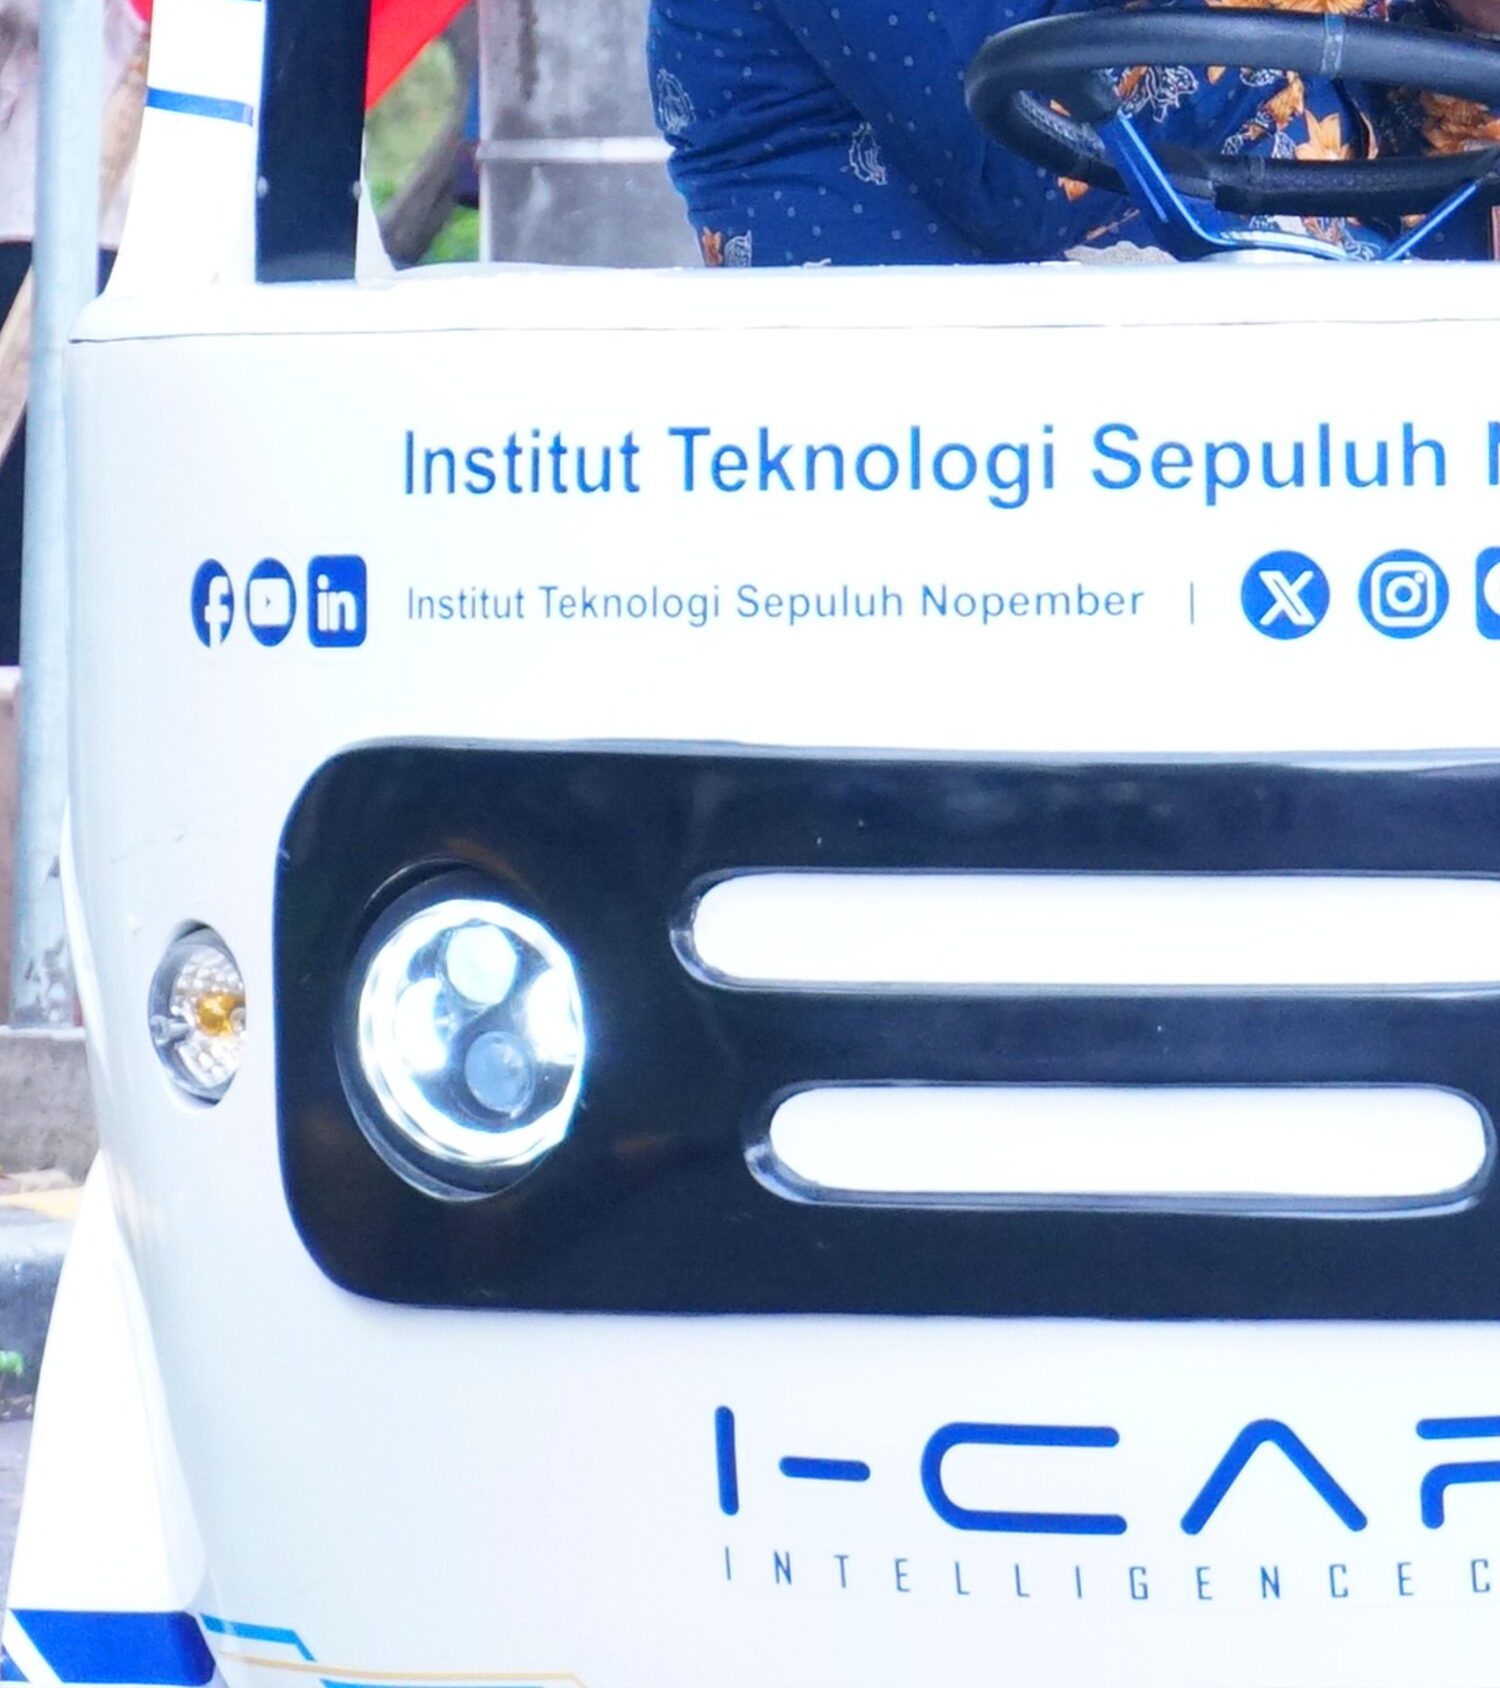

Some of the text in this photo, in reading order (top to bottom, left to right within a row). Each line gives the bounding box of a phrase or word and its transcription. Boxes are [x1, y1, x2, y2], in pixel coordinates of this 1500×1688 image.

[403, 427, 641, 496] Institut
[666, 423, 1055, 511] Teknologi
[1090, 421, 1447, 508] Sepuluh
[407, 583, 1145, 628] Institut Teknologi Sepuluh Nopember
